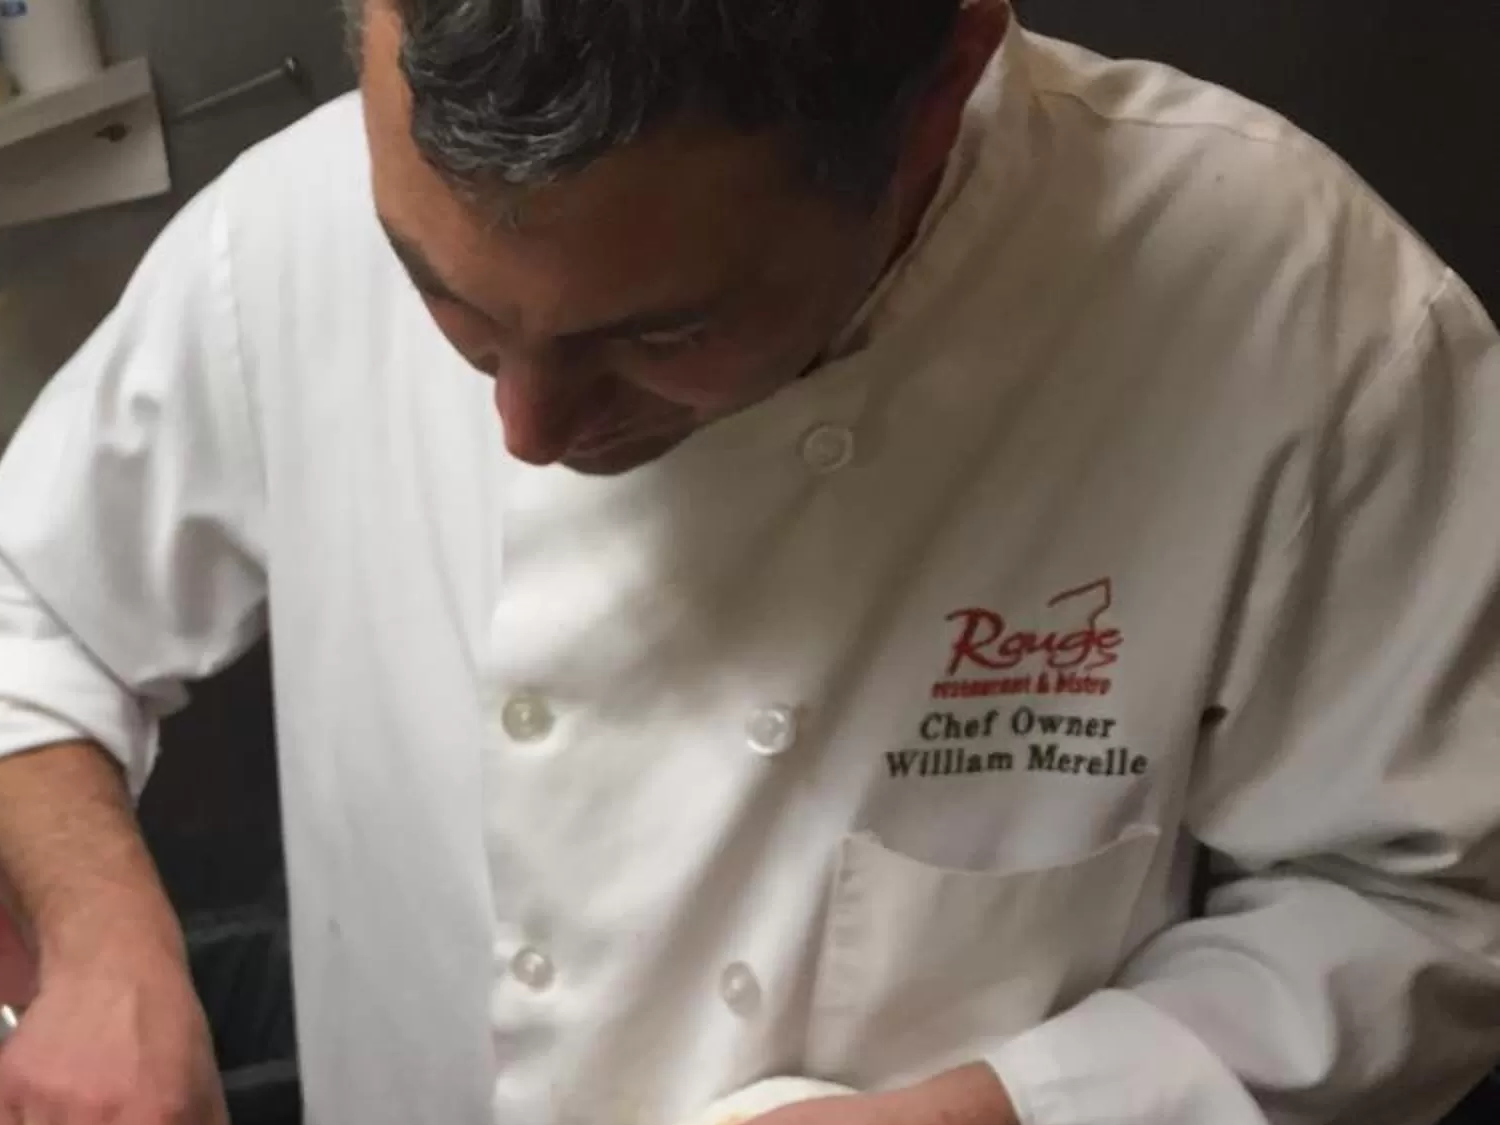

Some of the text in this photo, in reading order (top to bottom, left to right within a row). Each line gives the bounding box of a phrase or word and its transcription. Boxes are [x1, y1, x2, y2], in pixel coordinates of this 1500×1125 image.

[944, 607, 1123, 676] Rouge
[920, 706, 1116, 741] Chef Owner
[885, 743, 1148, 778] William Merelle
